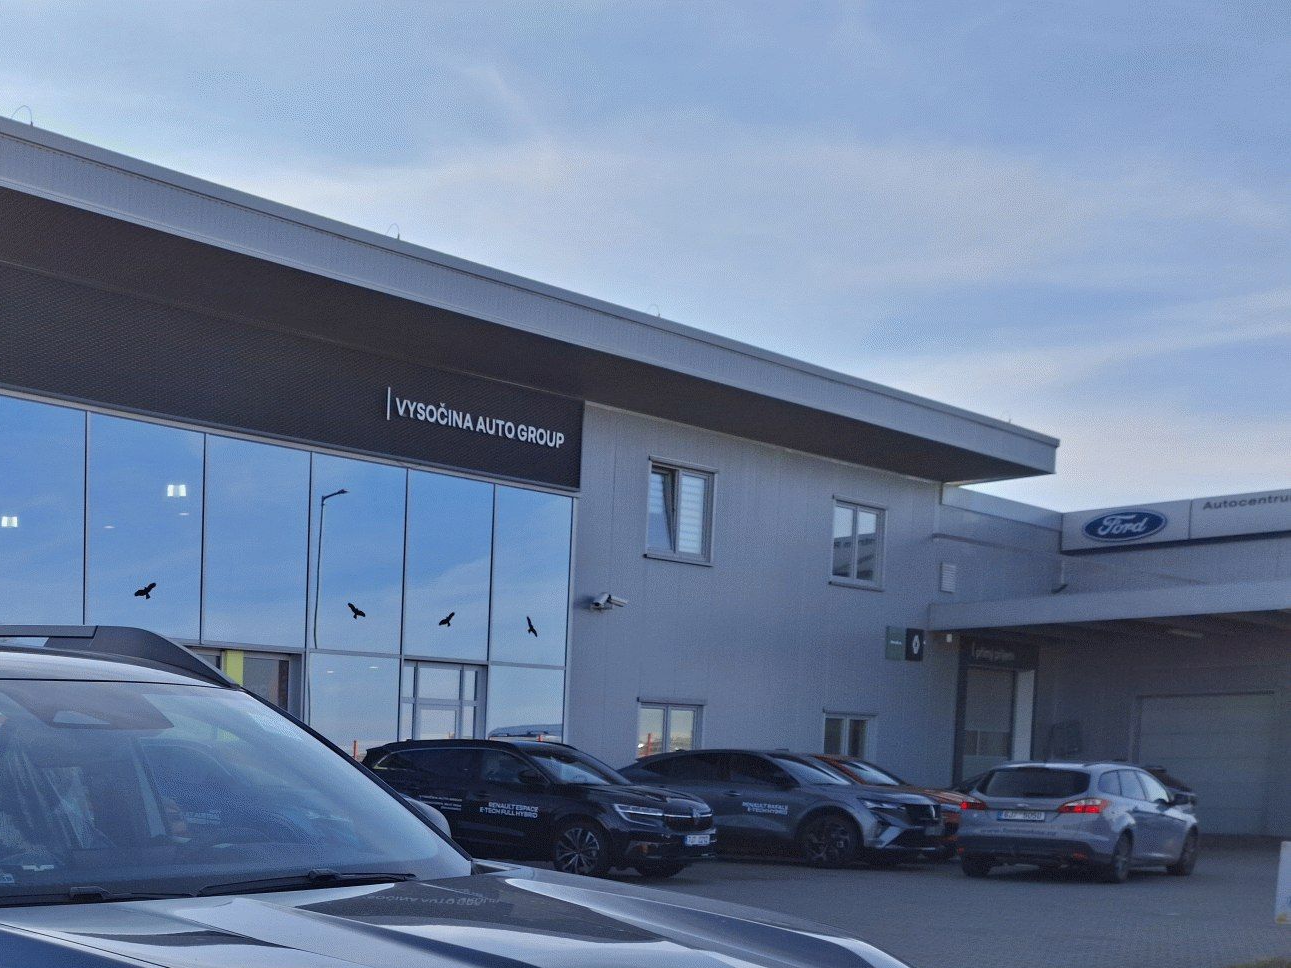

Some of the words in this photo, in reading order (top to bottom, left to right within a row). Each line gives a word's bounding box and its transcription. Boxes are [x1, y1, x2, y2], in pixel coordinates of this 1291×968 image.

[395, 397, 473, 431] VYSOČINA
[476, 416, 515, 439] AUTO
[517, 424, 565, 448] GROUP
[1097, 513, 1148, 536] Ford
[488, 801, 516, 811] RENAULT
